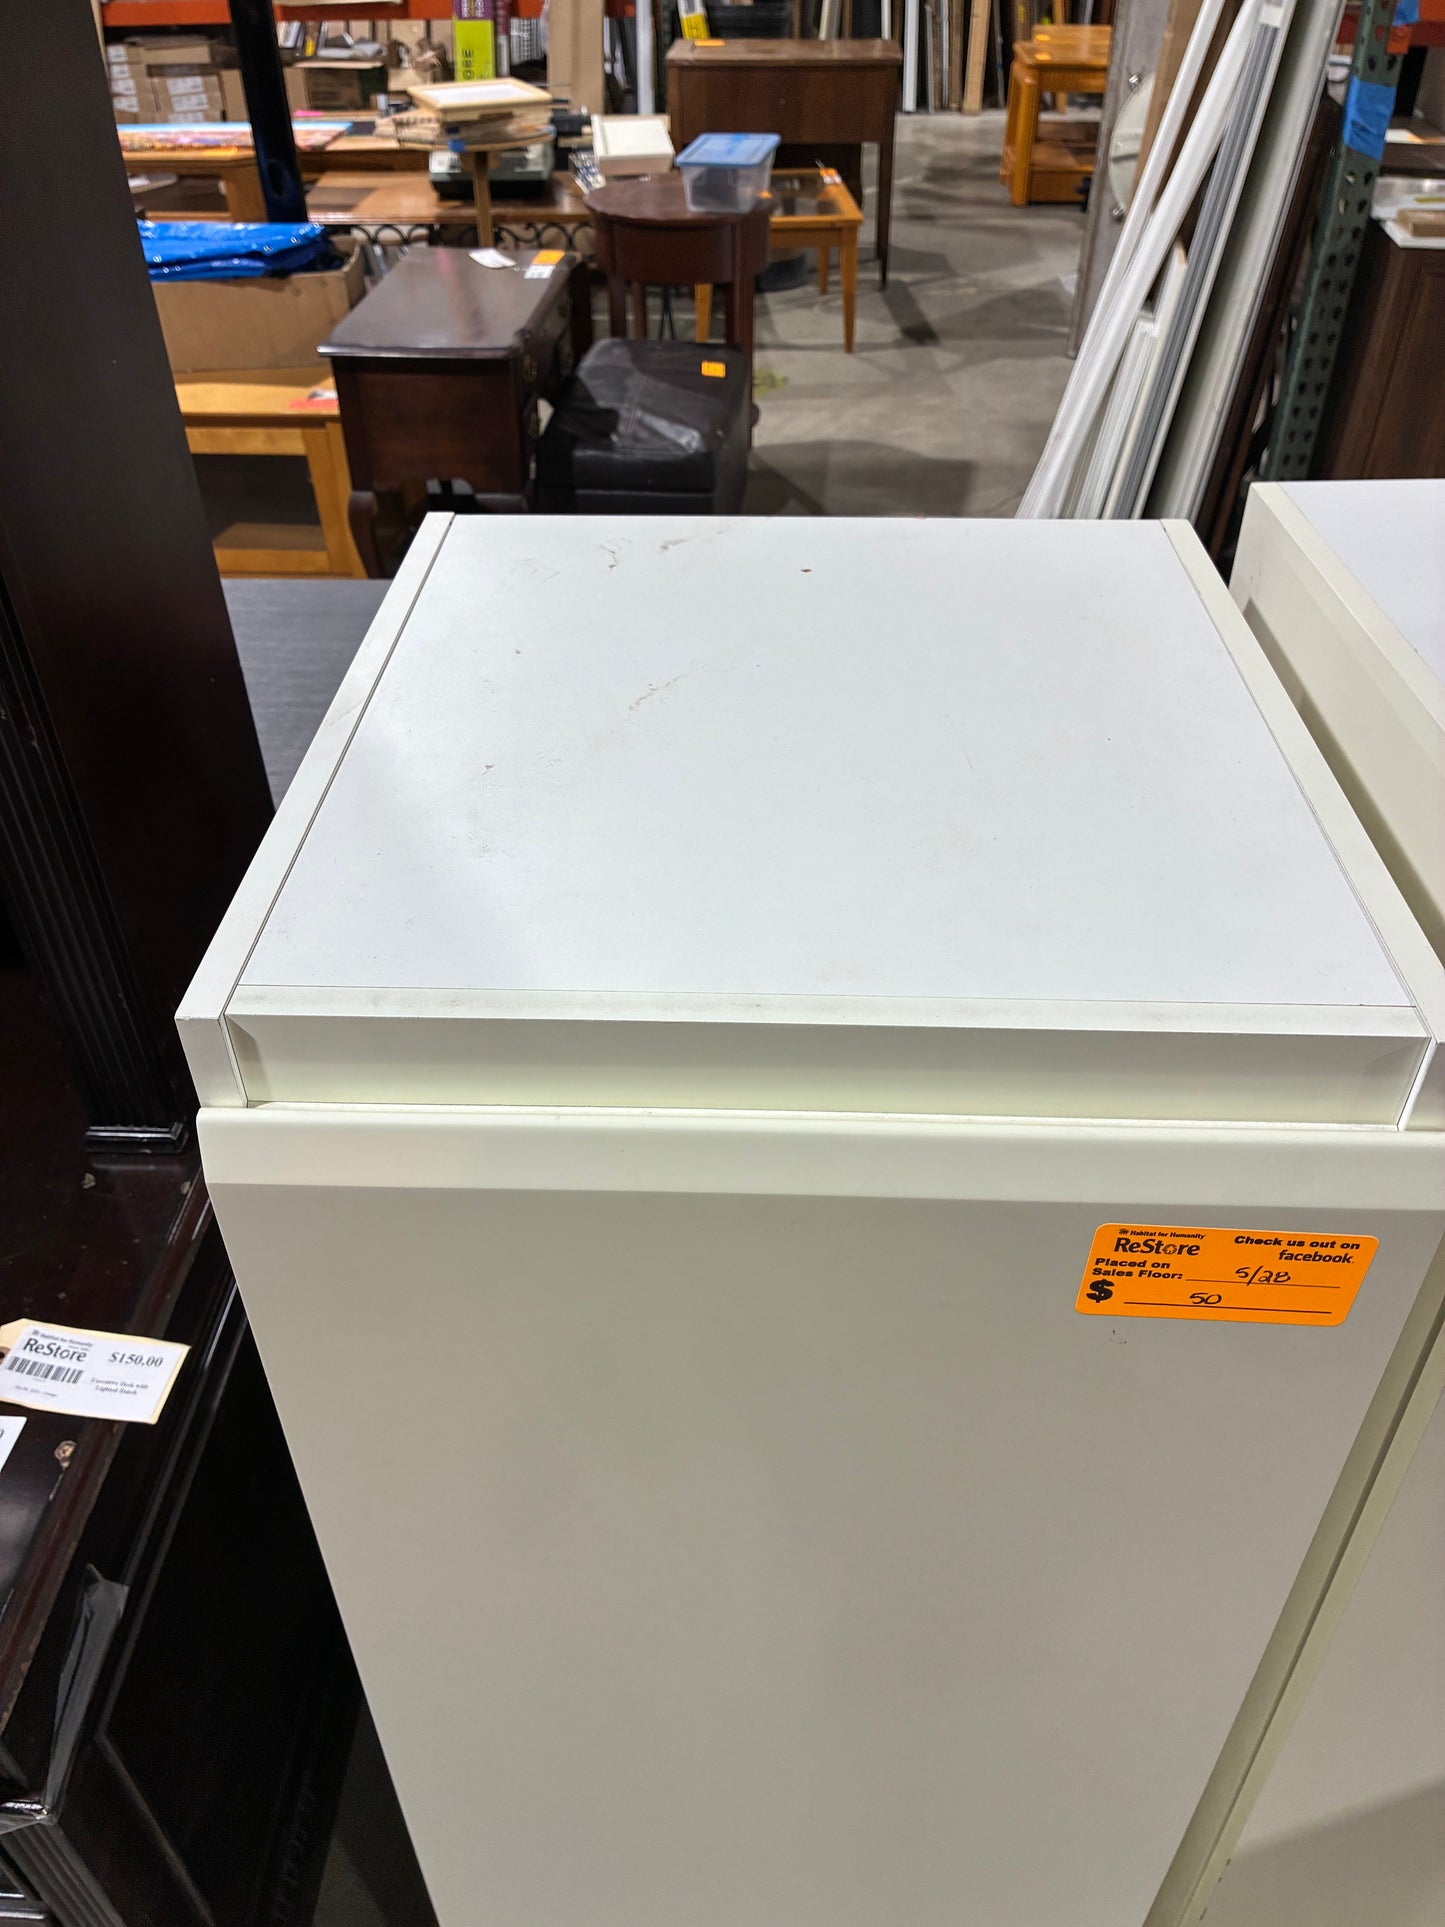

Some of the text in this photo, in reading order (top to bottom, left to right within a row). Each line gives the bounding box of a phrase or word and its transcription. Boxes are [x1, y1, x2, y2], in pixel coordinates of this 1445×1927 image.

[1130, 1229, 1156, 1237] Habitat
[1169, 1232, 1206, 1240] Humanity
[1234, 1235, 1283, 1246] Check
[1286, 1239, 1306, 1247] us
[1309, 1240, 1337, 1249] out
[1114, 1237, 1200, 1256] ReStore
[1094, 1258, 1148, 1268] Placed
[1092, 1268, 1184, 1279] Sales Floor:
[1234, 1265, 1291, 1286] 5/28
[1086, 1279, 1115, 1303] $
[1189, 1292, 1222, 1305] 50
[23, 1337, 87, 1362] ReStore
[108, 1352, 164, 1368] $150.00
